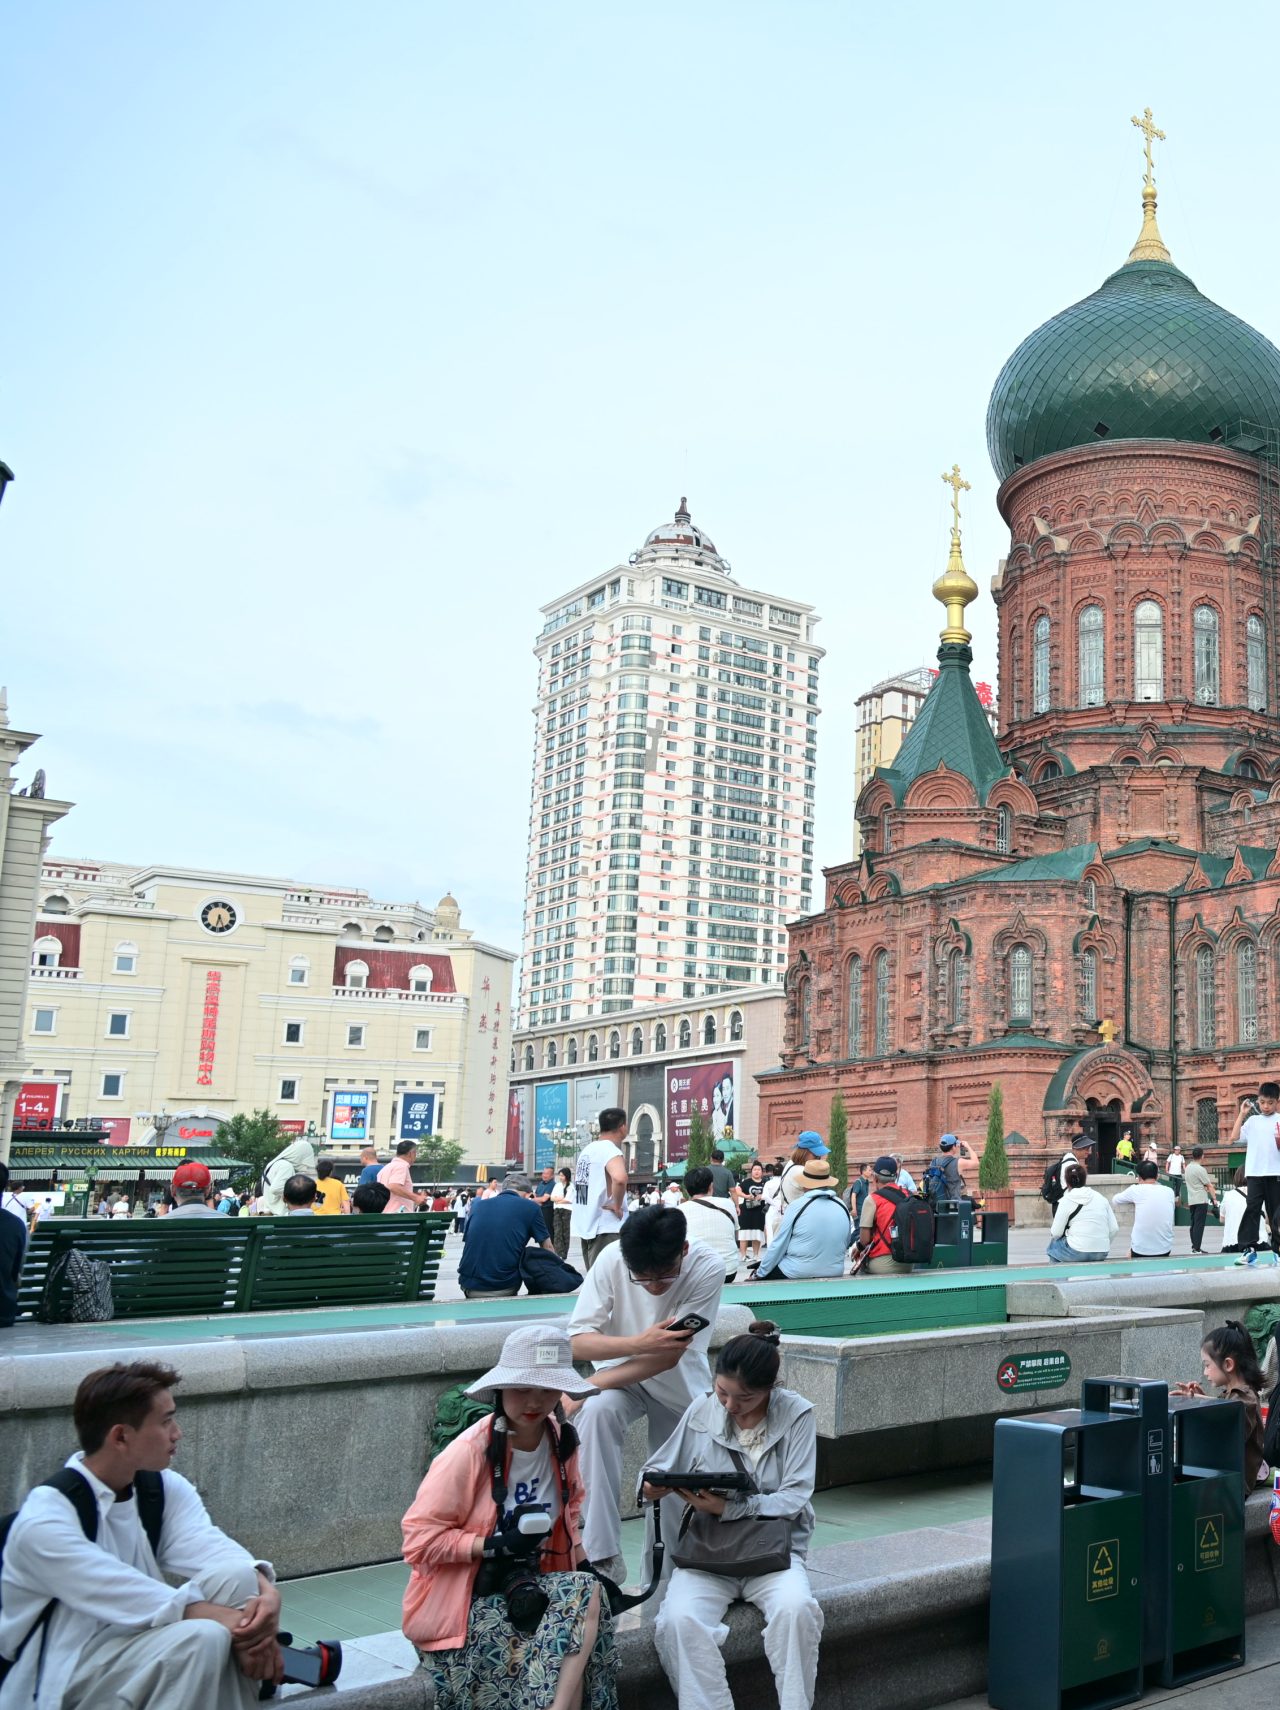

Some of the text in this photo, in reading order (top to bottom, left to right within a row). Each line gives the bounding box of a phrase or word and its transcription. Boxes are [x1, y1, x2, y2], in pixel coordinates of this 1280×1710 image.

[61, 1147, 106, 1156] РУССКИХ
[112, 1148, 150, 1156] КАРТИН
[514, 1477, 540, 1504] BE
